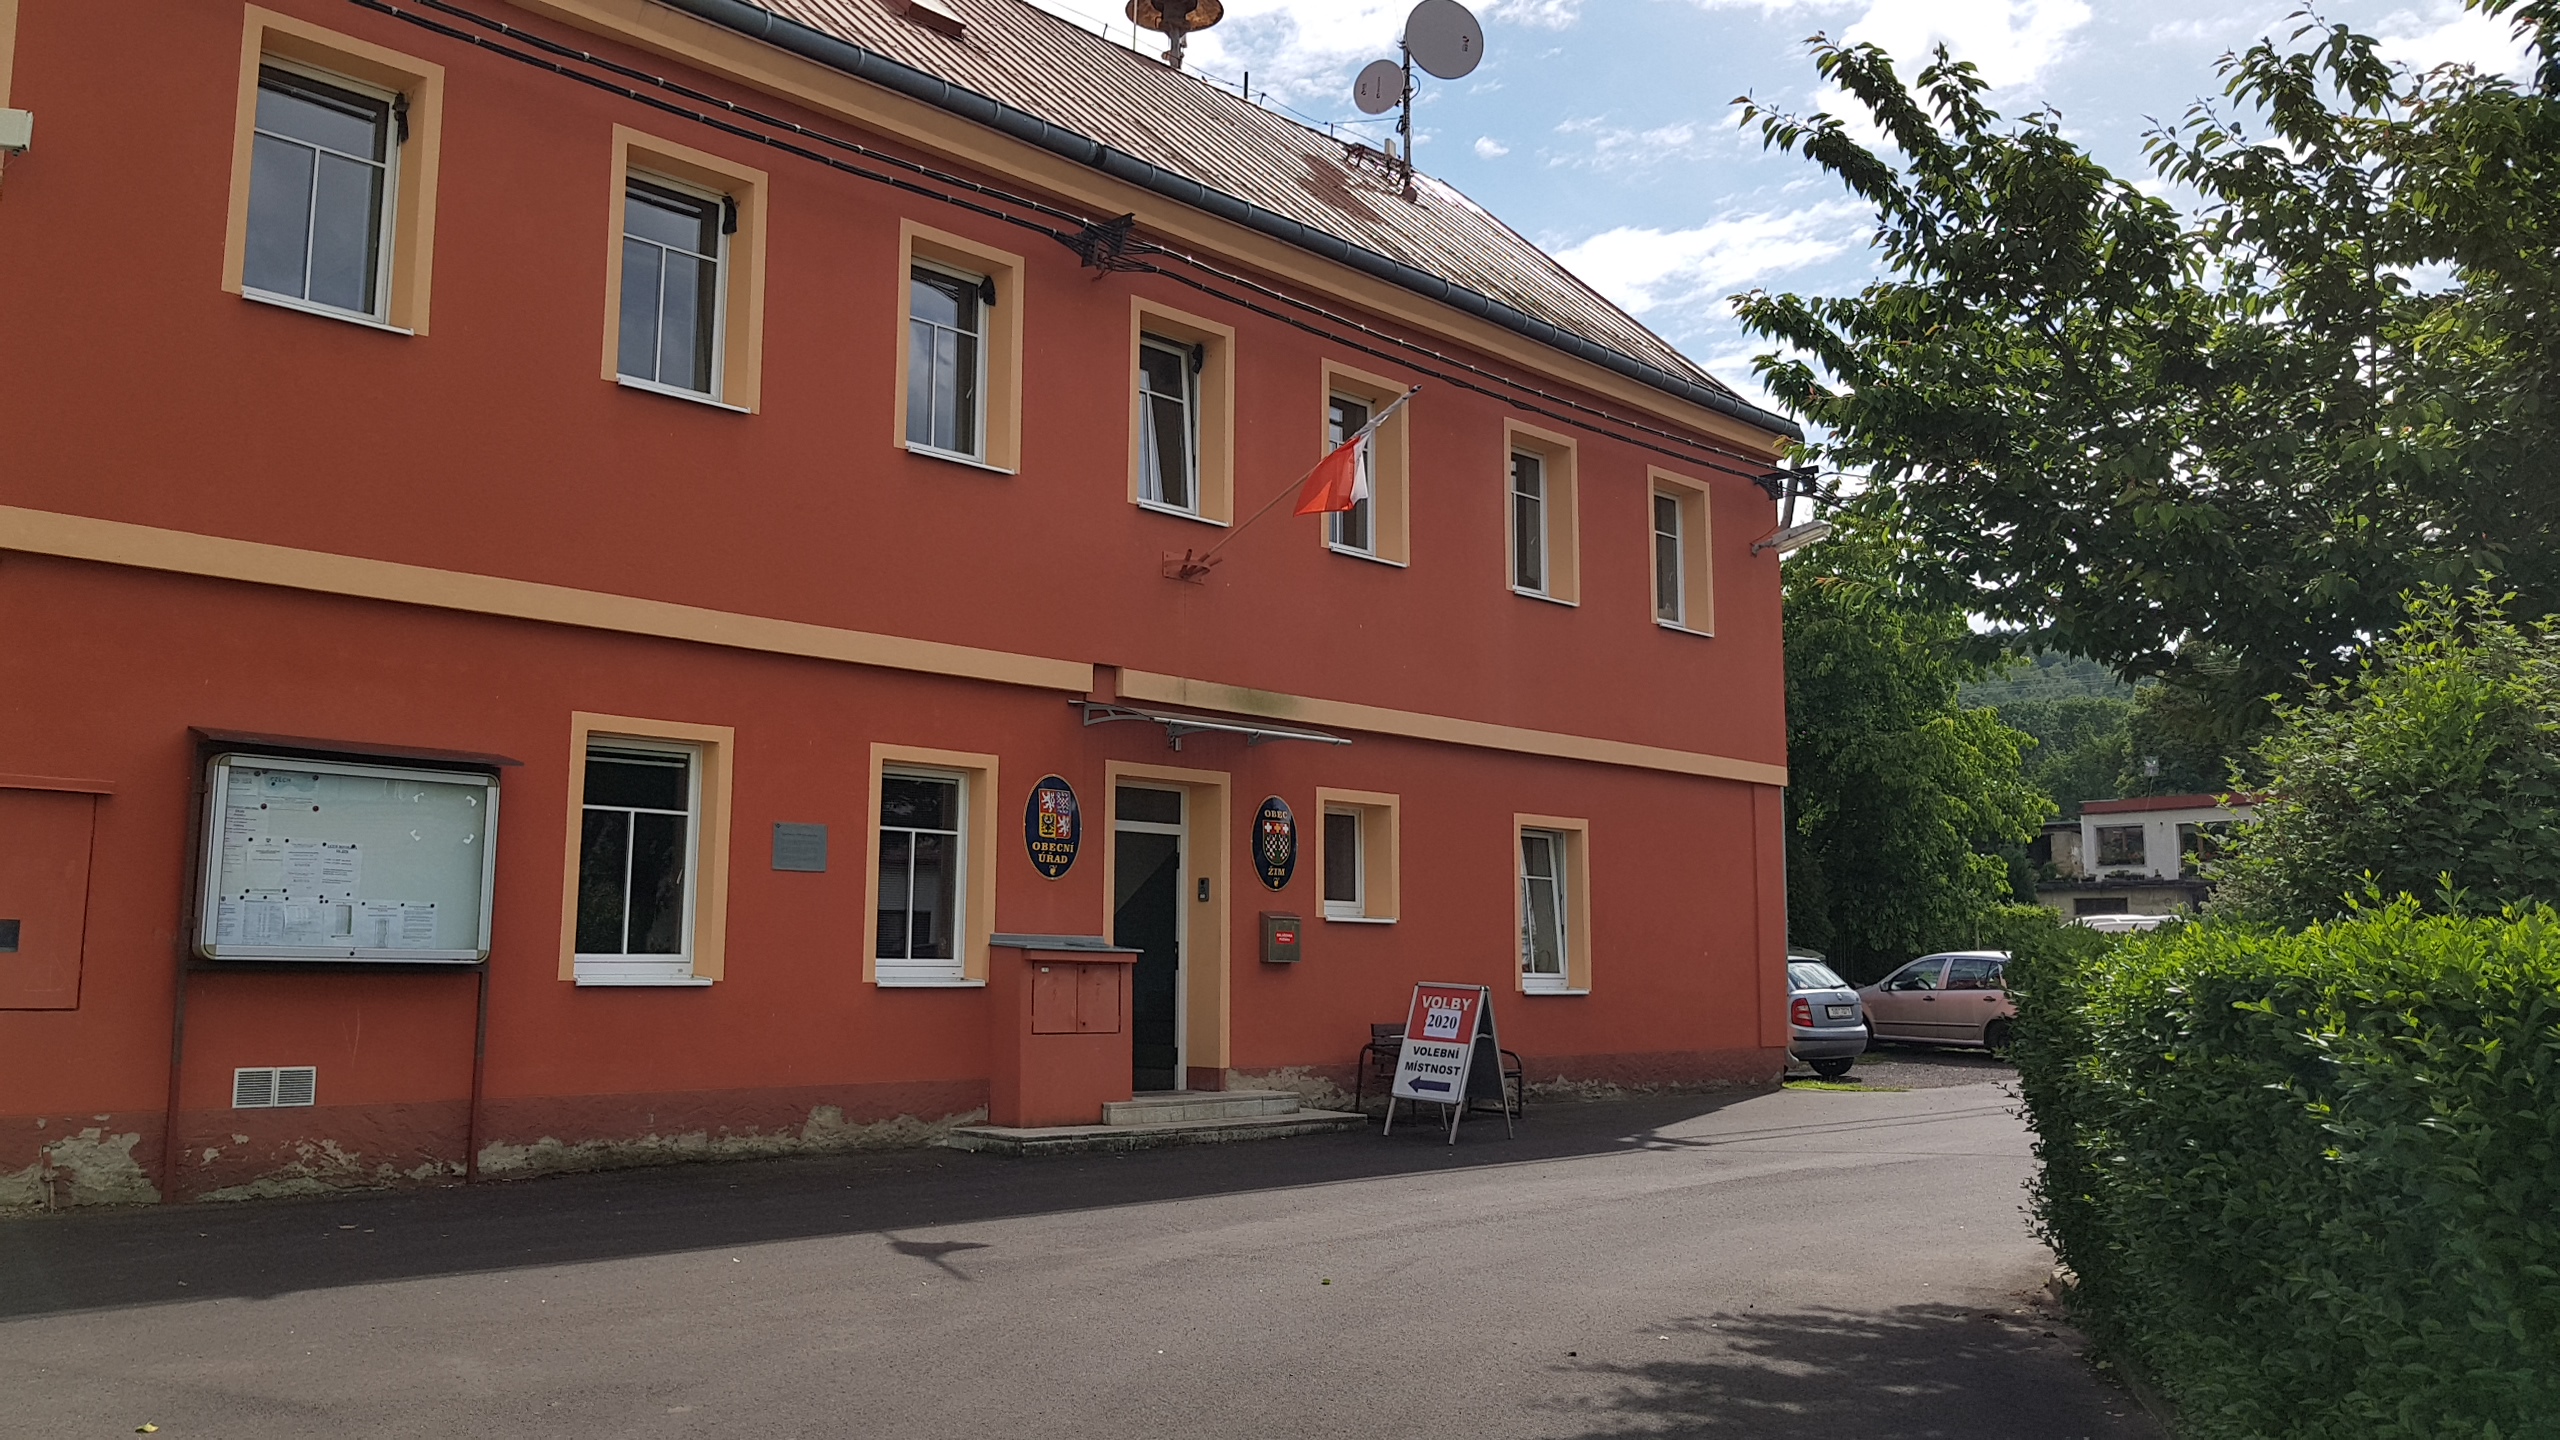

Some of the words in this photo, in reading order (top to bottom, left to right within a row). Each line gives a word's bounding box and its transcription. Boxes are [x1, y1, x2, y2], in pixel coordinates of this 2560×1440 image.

[1264, 809, 1288, 820] OBEC
[1032, 841, 1075, 854] OBECNÍ
[1038, 852, 1069, 865] ÚŘAD
[1268, 866, 1286, 877] ŽIM
[1422, 995, 1473, 1011] VOLBY
[1427, 1014, 1457, 1029] 2020
[1413, 1046, 1461, 1060] VOLEBNÍ
[1404, 1060, 1461, 1076] MÍSTNOST
